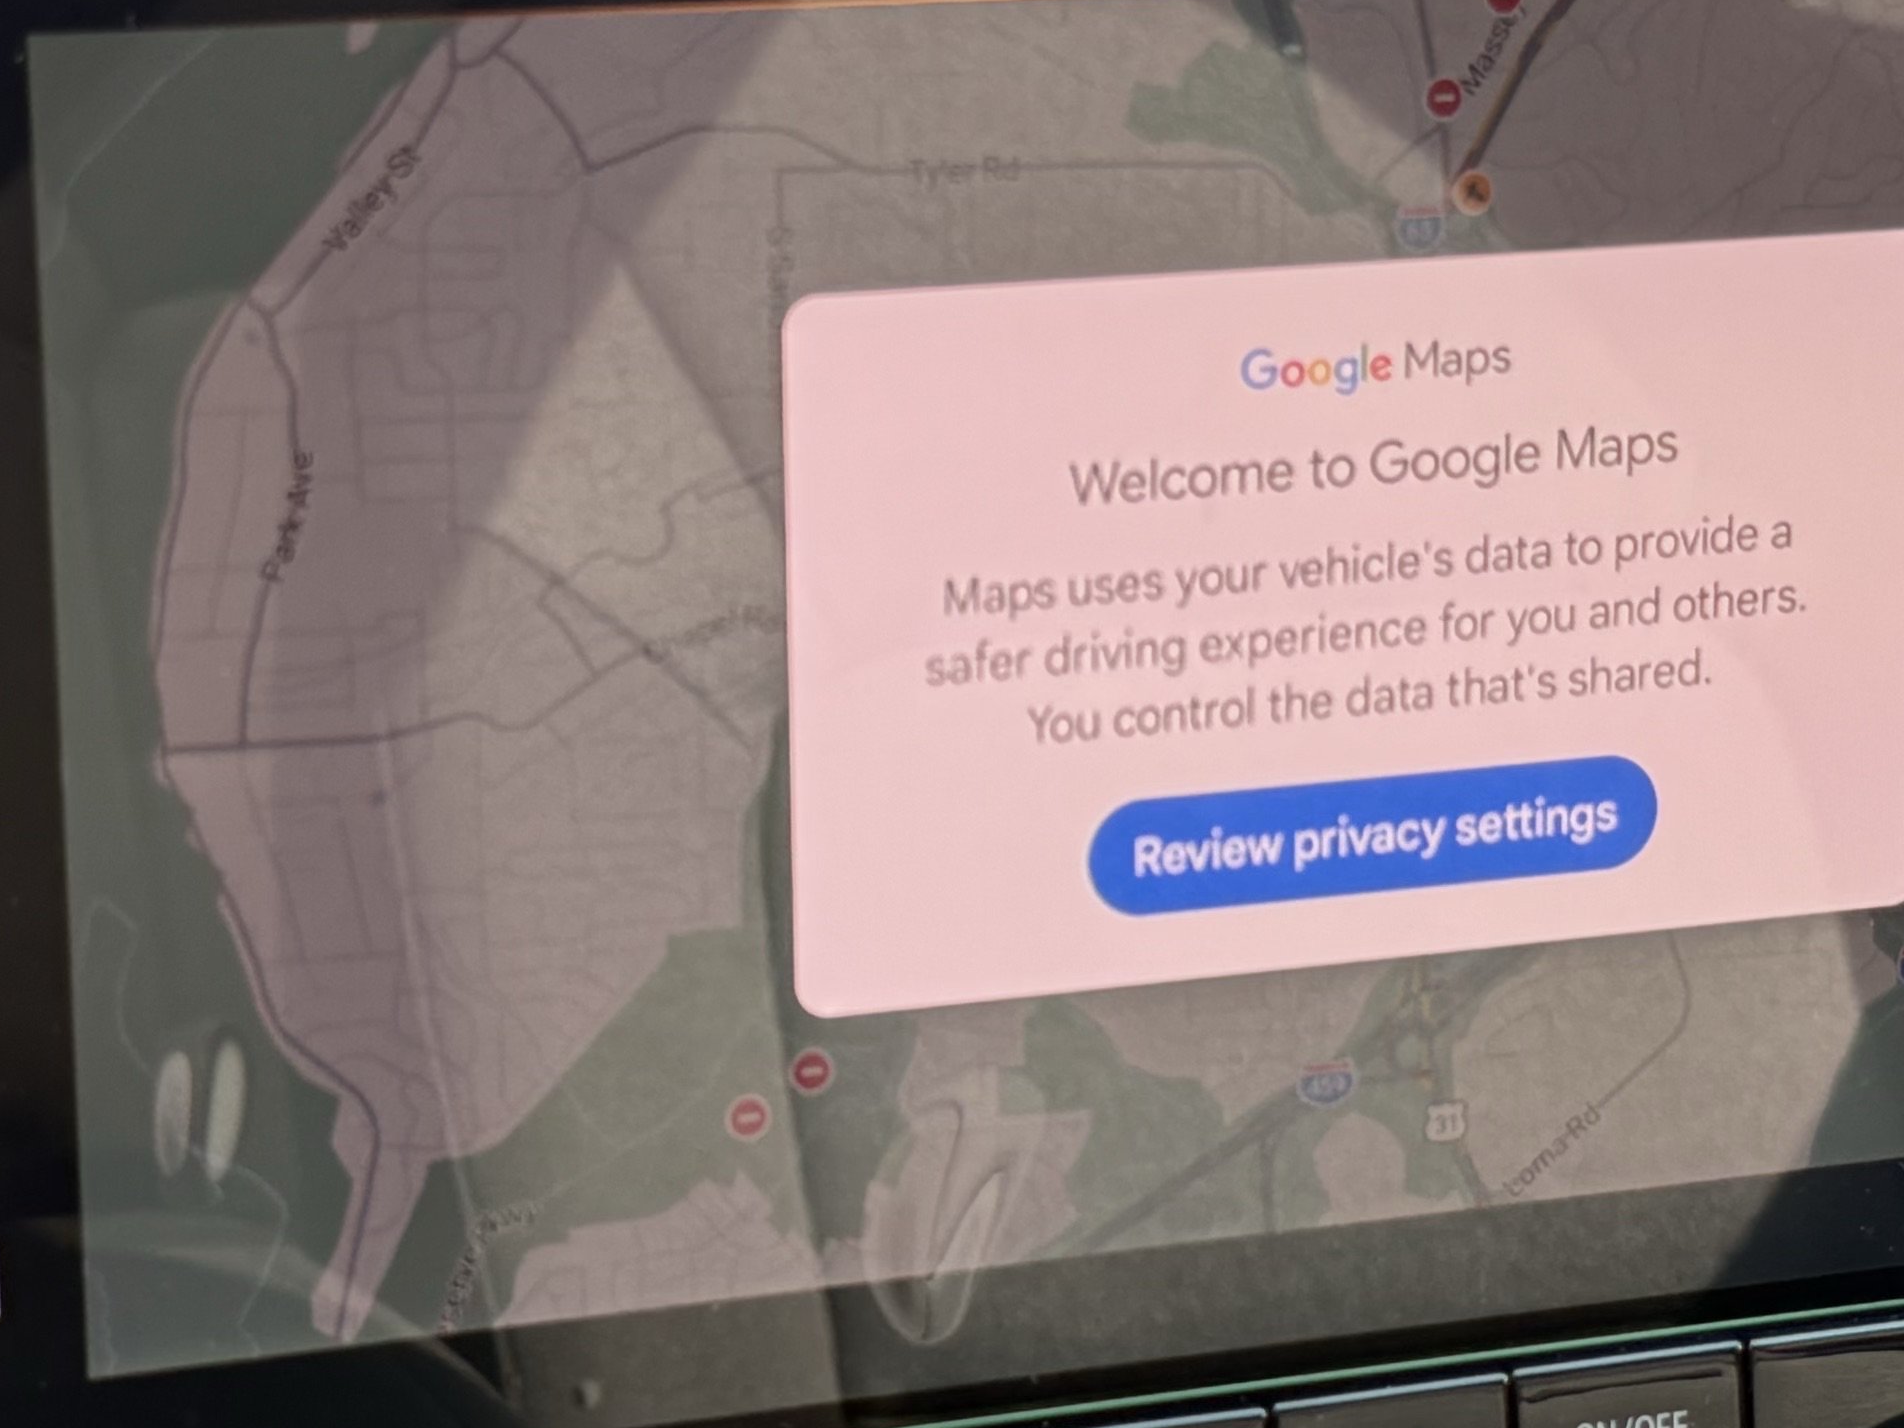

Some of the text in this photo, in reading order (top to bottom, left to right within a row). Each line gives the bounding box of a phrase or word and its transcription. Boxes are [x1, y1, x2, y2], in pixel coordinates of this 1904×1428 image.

[322, 143, 422, 251] Valley St
[983, 155, 1021, 183] Rd
[1240, 339, 1513, 396] Google Maps
[1068, 425, 1679, 507] Welcome to Google Maps
[943, 514, 1793, 622] Maps uses your vehicle's data to provide a
[924, 581, 1808, 686] safer driving experience for you and others.
[1027, 646, 1713, 745] You control the data that's shared.
[1133, 795, 1619, 878] Review privacy settings
[1434, 1112, 1457, 1135] 31
[1565, 1101, 1601, 1140] Rd
